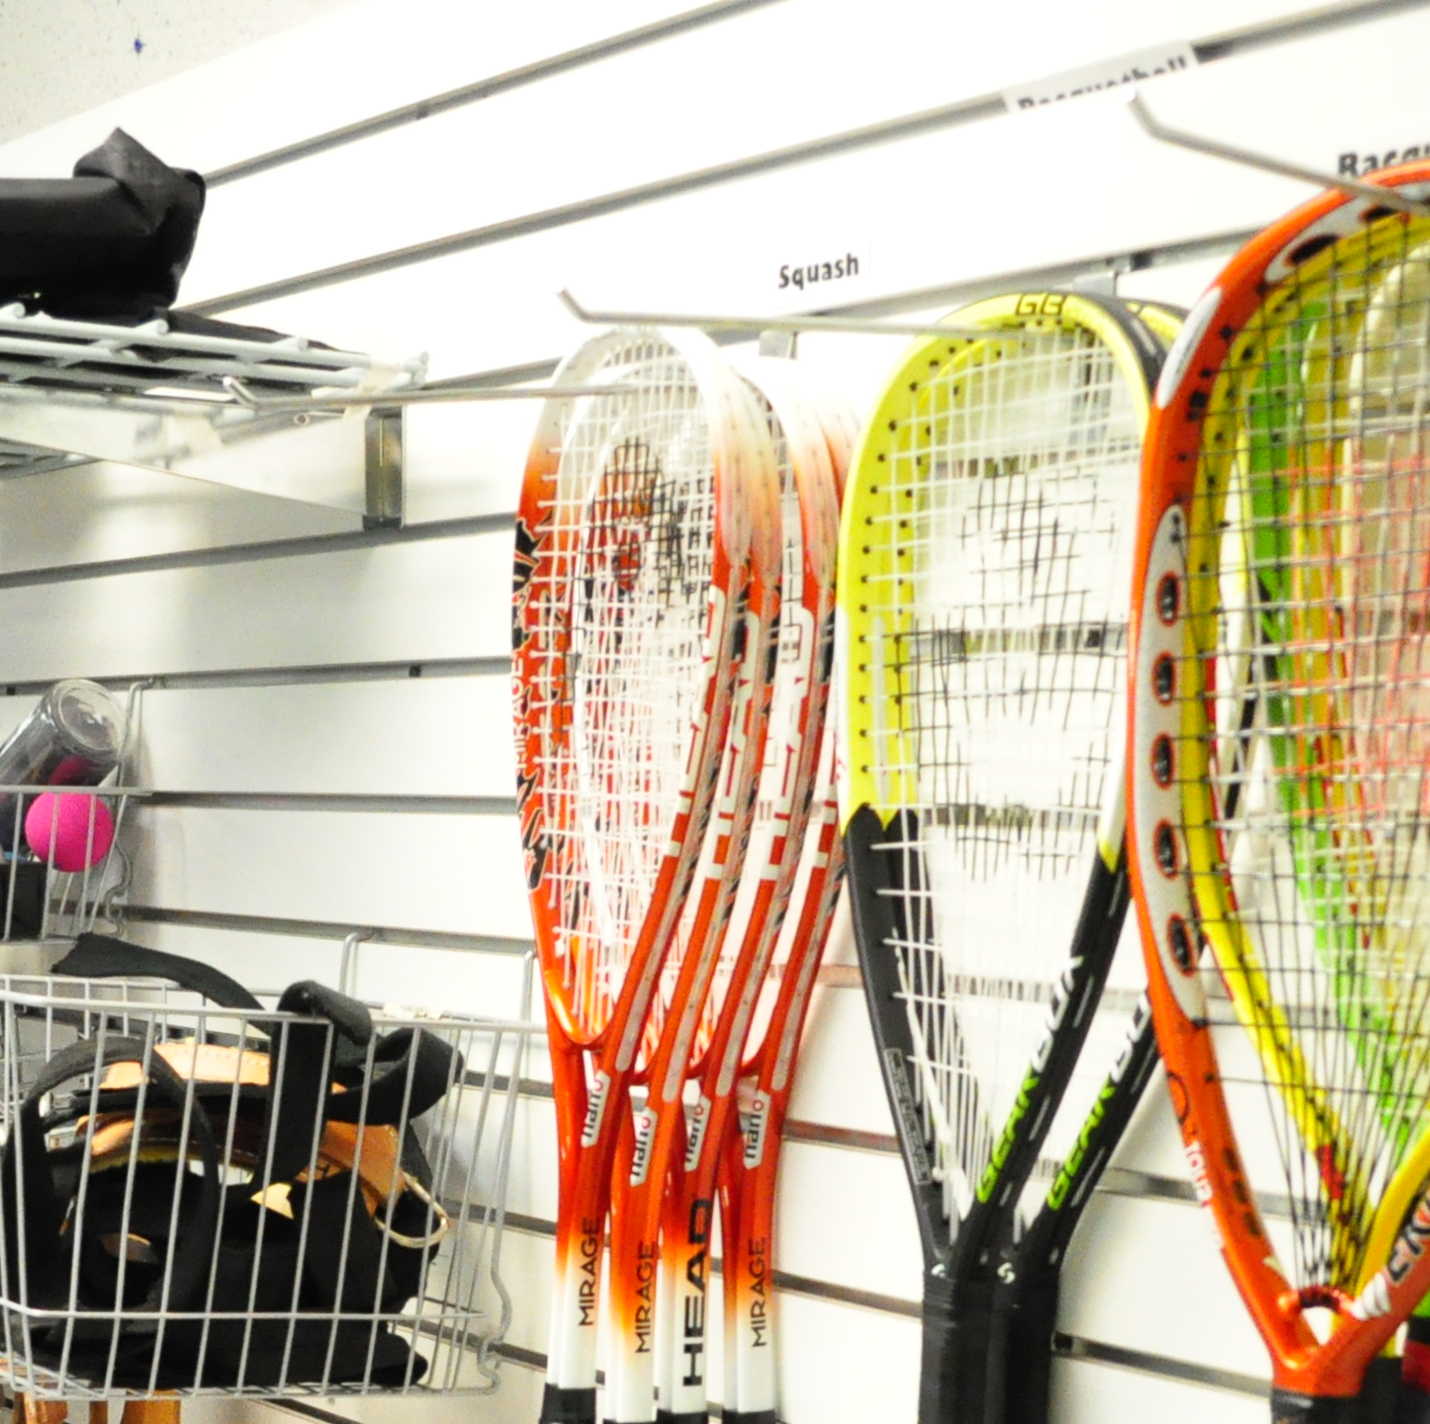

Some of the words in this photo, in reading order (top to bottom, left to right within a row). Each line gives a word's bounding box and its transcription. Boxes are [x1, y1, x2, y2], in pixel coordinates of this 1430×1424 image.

[778, 253, 860, 291] Squash
[579, 1216, 601, 1327] MIRAGE
[635, 1240, 658, 1355] MIRAGE
[683, 1198, 710, 1387] HEAD
[749, 1235, 767, 1348] MIRAGE
